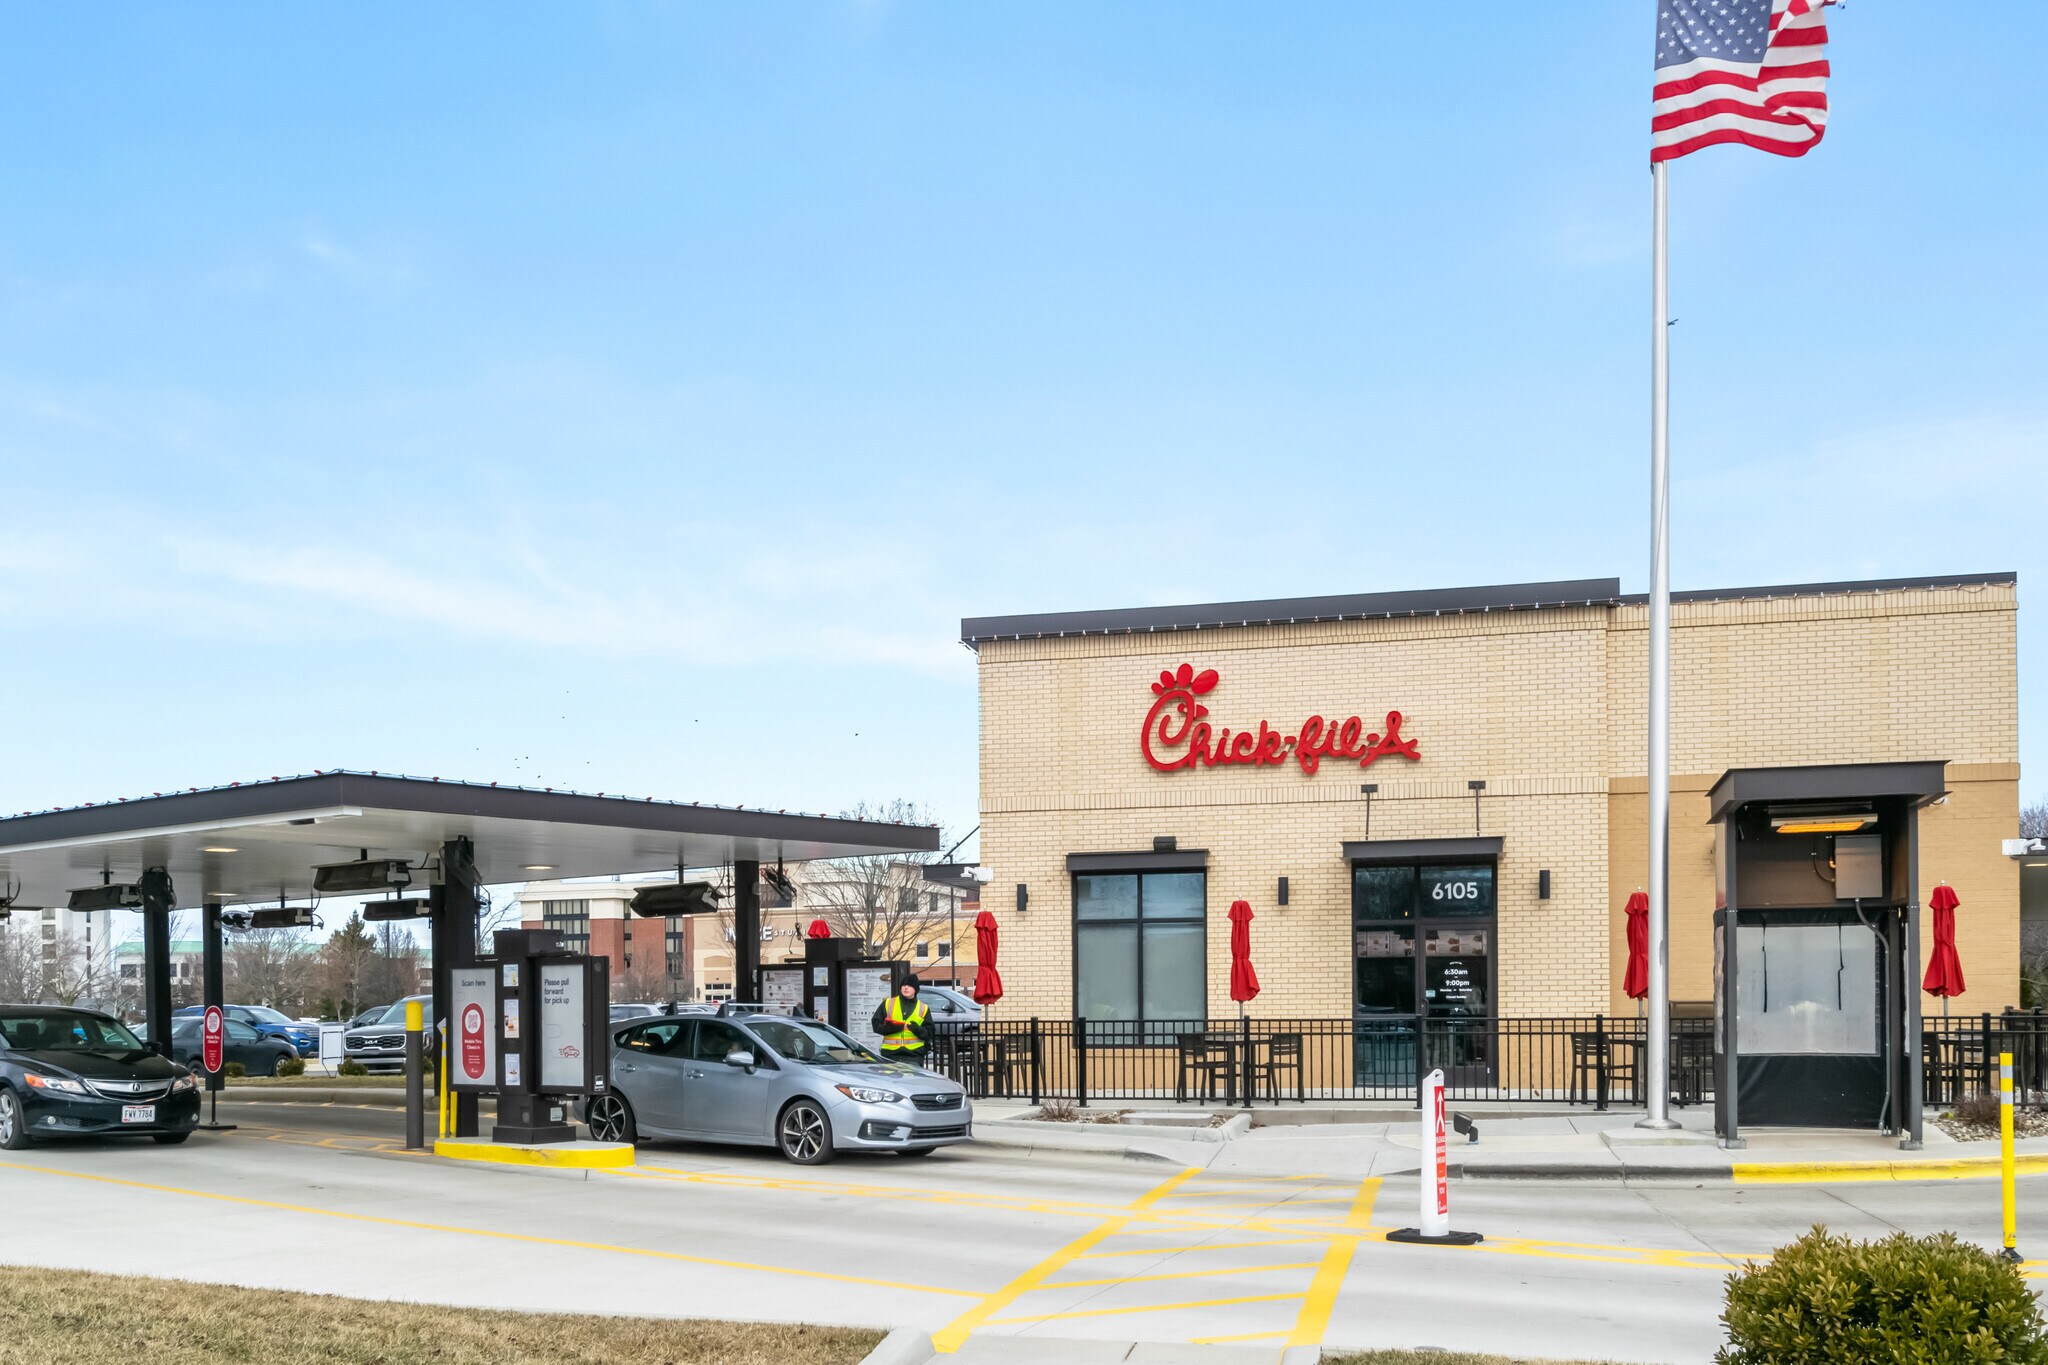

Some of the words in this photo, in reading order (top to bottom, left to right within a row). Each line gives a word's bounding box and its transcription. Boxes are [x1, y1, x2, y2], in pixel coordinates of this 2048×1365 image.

[1141, 663, 1421, 775] Chick-fil-A
[1432, 882, 1478, 900] 6105
[475, 979, 486, 987] here
[561, 978, 570, 987] pull
[552, 997, 563, 1005] pick
